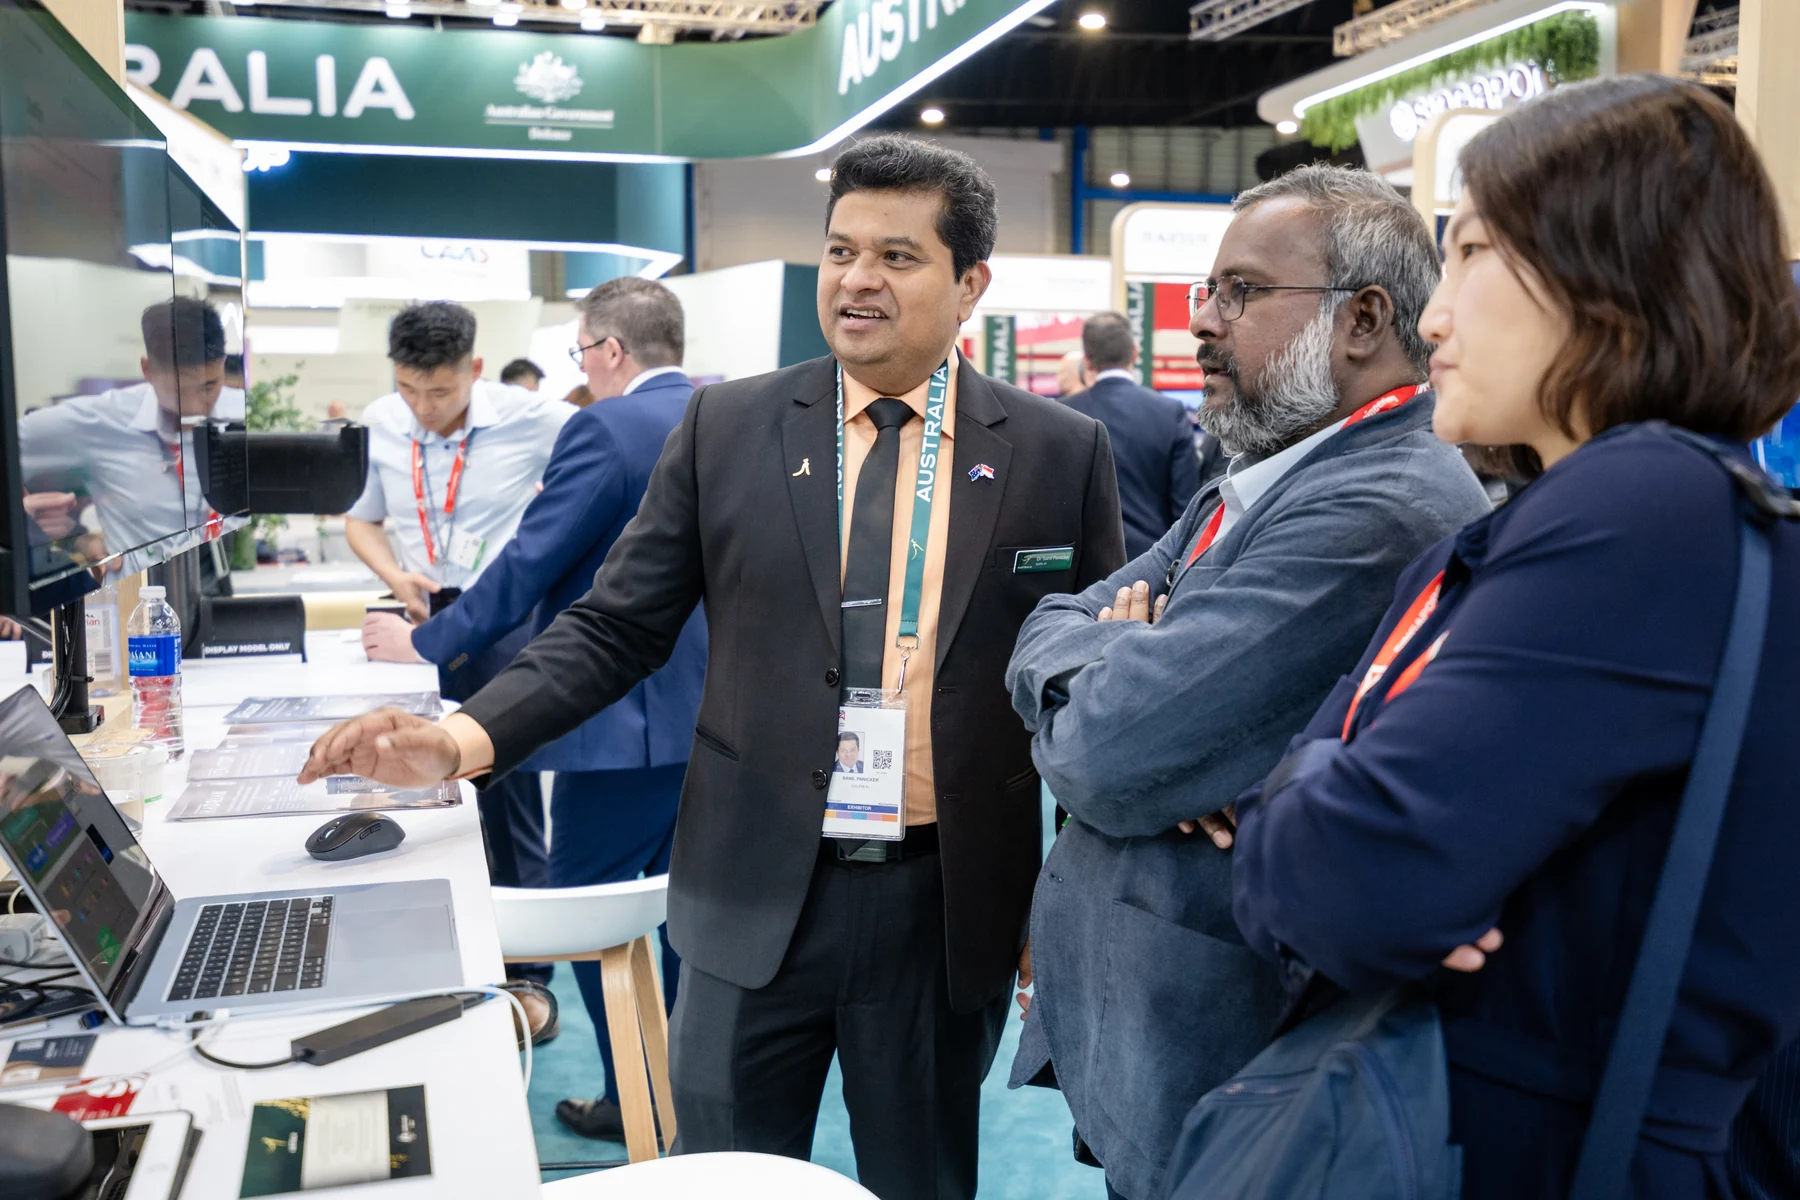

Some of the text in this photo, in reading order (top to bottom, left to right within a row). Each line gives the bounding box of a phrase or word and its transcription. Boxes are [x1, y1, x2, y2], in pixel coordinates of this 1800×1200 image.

[916, 366, 947, 503] AUSTRALIA
[205, 642, 291, 655] DISPLAY MODEL ONLY
